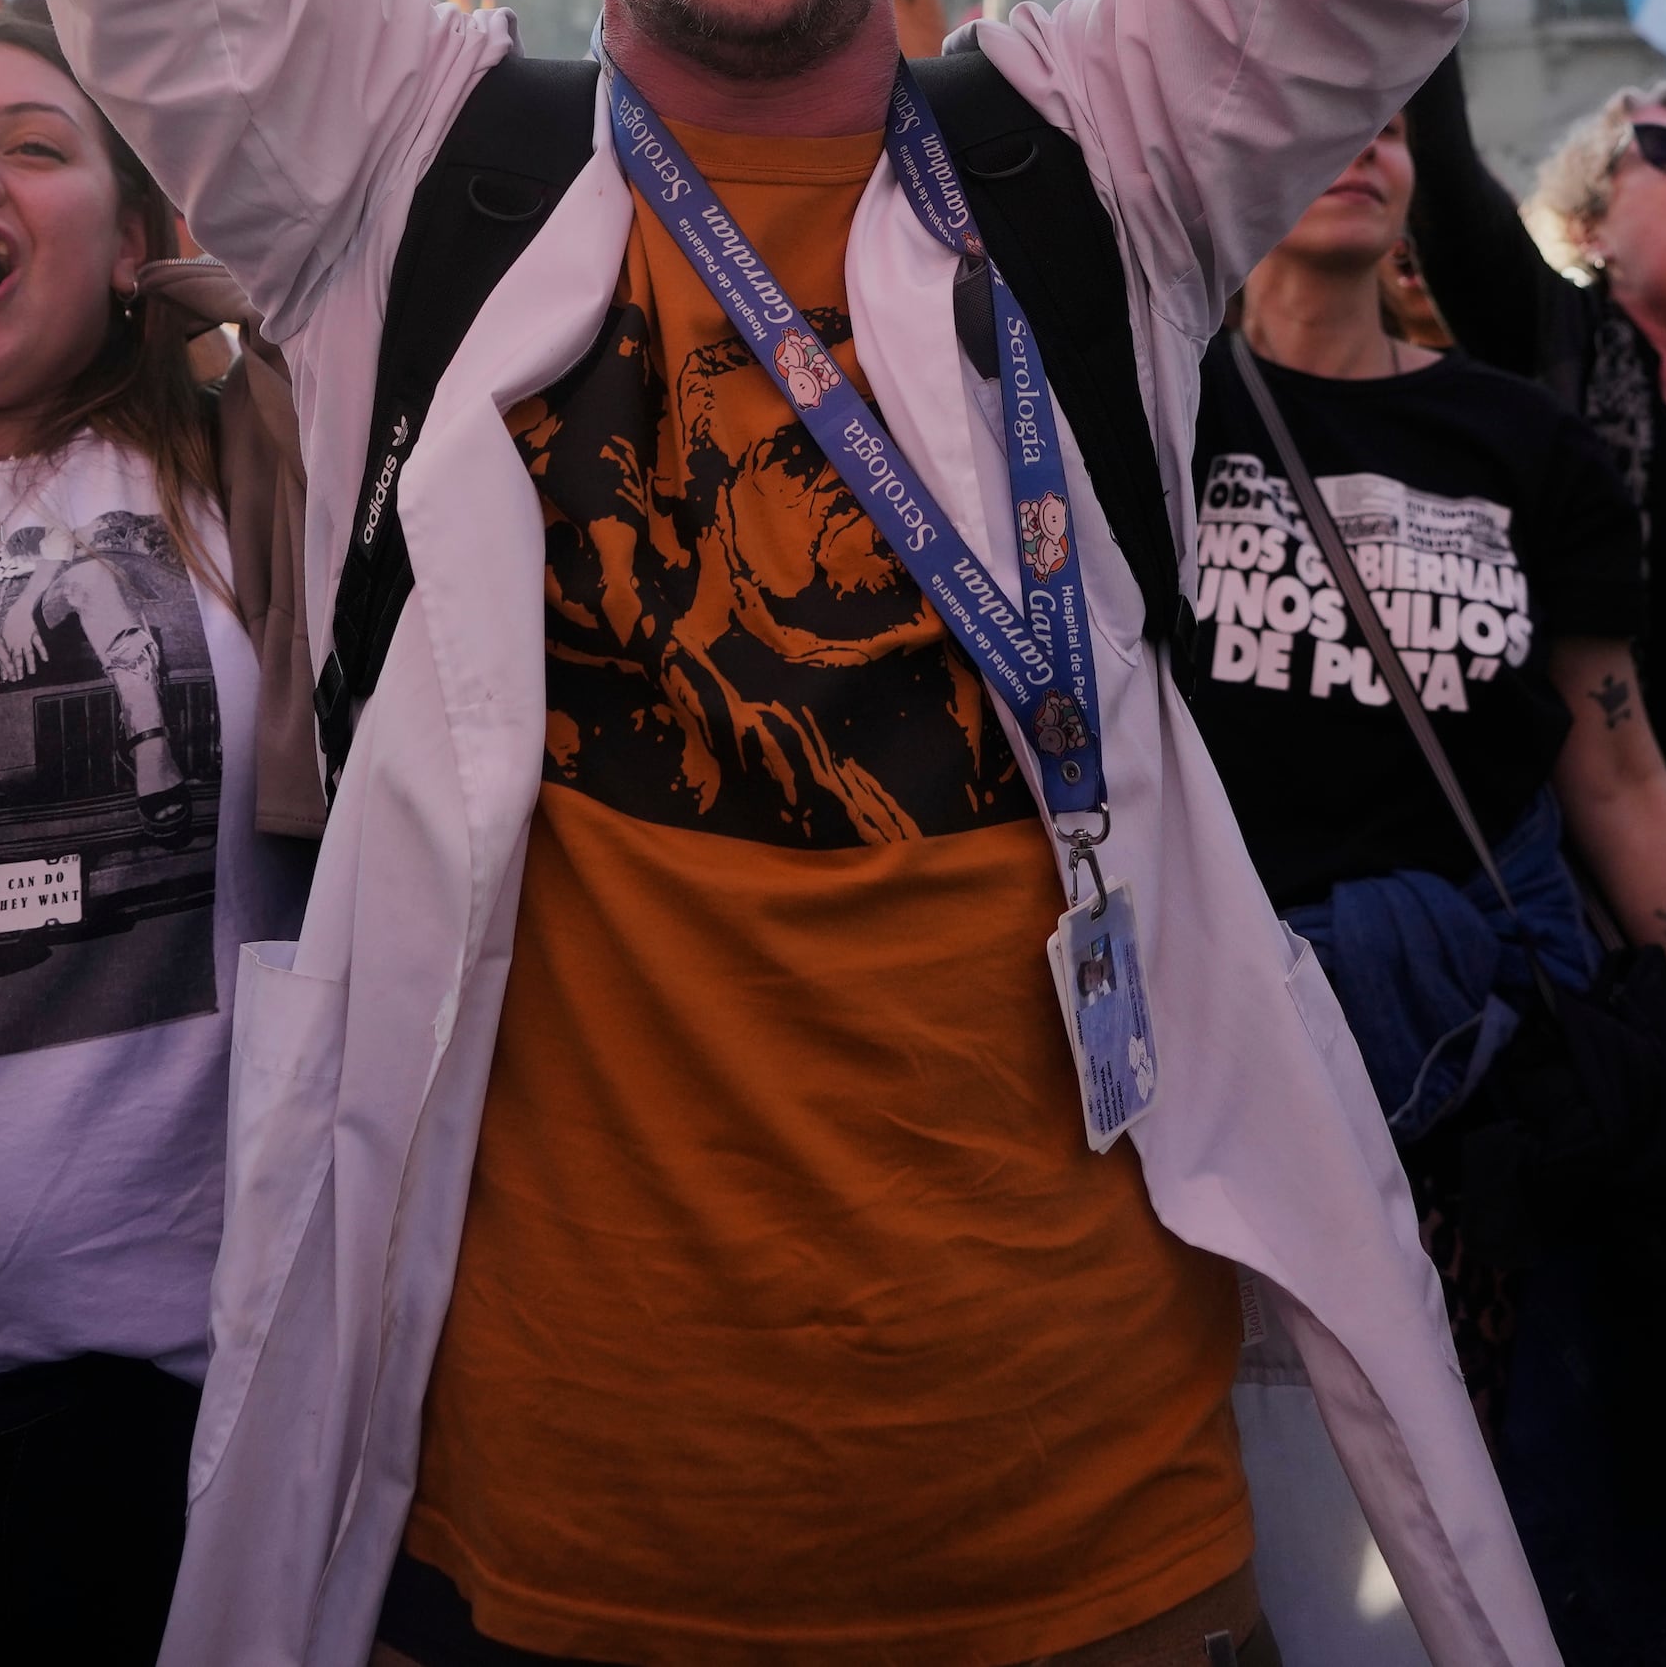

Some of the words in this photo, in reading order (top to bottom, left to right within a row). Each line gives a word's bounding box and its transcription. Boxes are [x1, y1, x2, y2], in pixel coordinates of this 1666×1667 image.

[617, 94, 693, 203] Serología
[921, 133, 970, 229] Garrahan
[677, 217, 719, 274] Pediatría
[701, 203, 794, 325] Garrahan
[717, 270, 734, 291] de
[731, 289, 768, 342] Hospital
[1006, 316, 1047, 467] Serología
[363, 453, 398, 545] adidas
[843, 418, 938, 553] Serología
[931, 573, 977, 636] Pediatría
[952, 556, 1054, 686] Garrahan
[1061, 584, 1081, 650] Hospital
[1369, 589, 1533, 668] HIJOS
[974, 632, 993, 655] de
[986, 648, 1031, 705] Hospital
[1070, 653, 1084, 673] de
[1211, 623, 1294, 691] DE
[8, 876, 36, 890] CAN
[44, 871, 65, 885] DO
[38, 889, 80, 907] WANT
